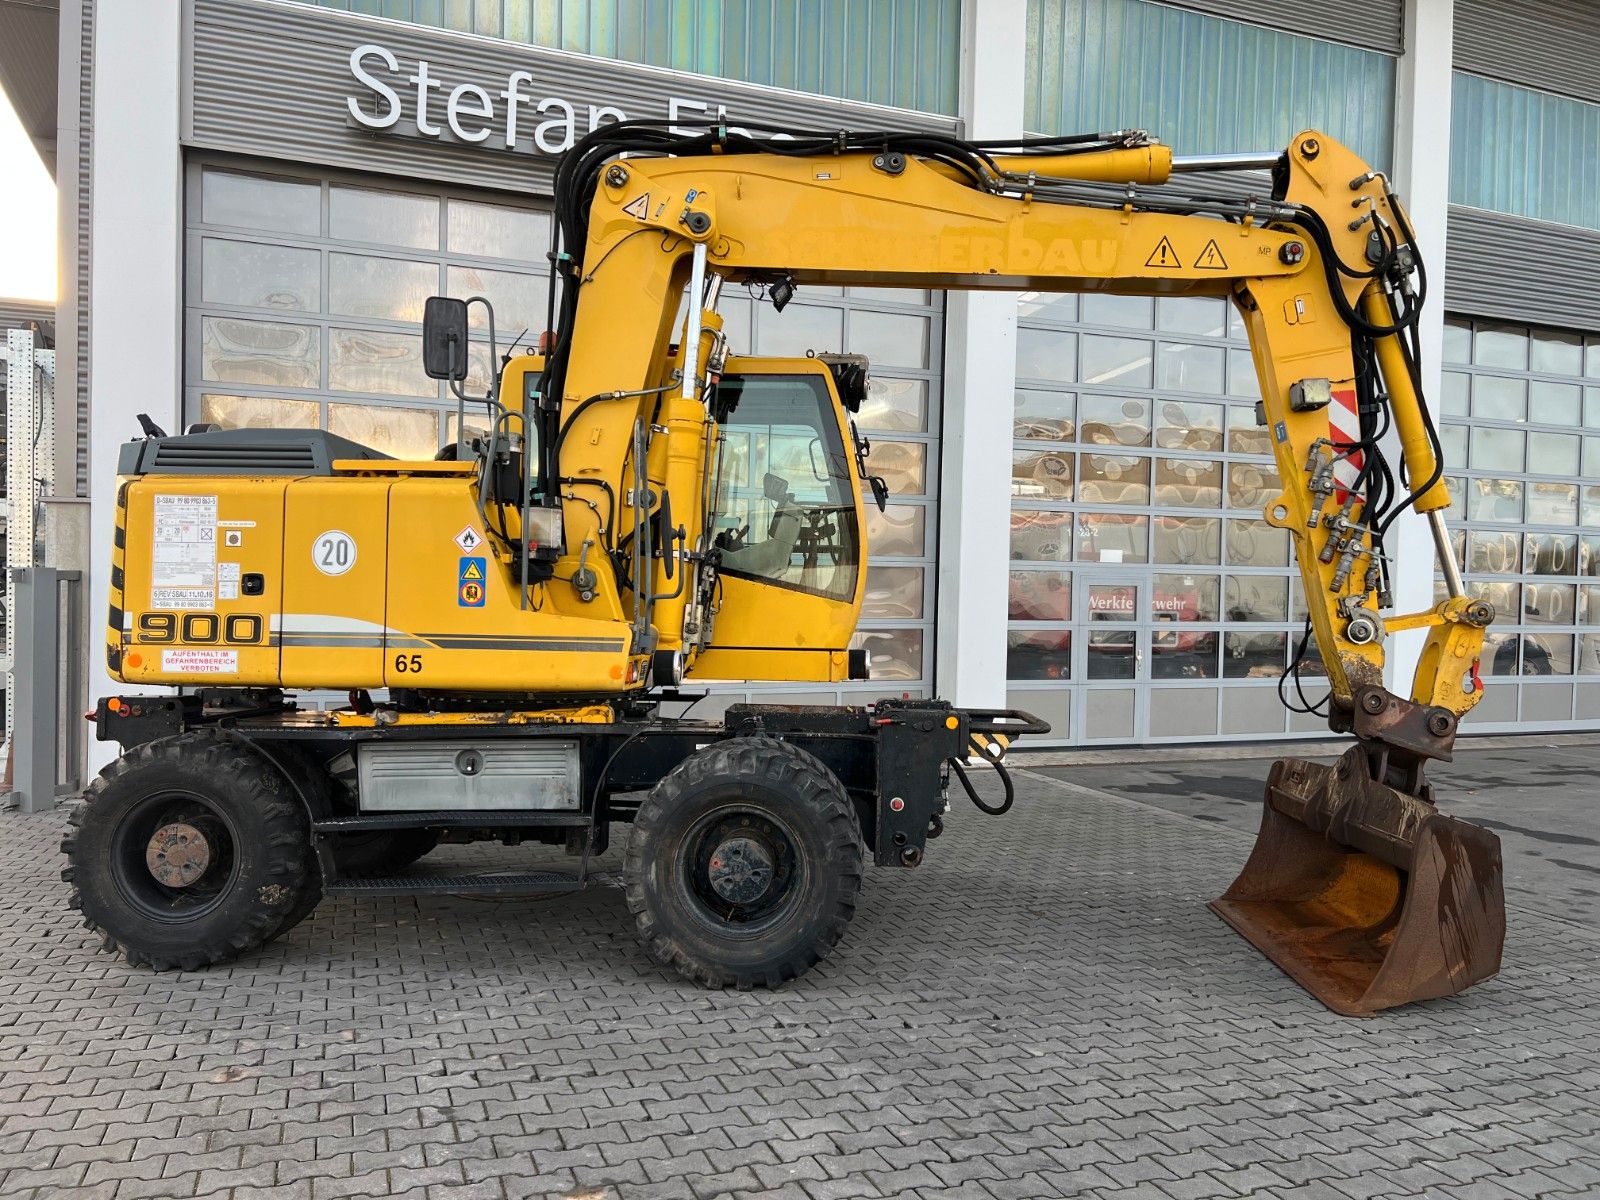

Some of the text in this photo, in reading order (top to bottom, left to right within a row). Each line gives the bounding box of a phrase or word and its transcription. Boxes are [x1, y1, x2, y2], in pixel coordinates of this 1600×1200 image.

[1258, 246, 1272, 255] MP
[321, 539, 349, 566] 20
[138, 612, 263, 645] 900
[165, 657, 236, 665] GEFAHRENBEREICH
[395, 654, 423, 673] 65
